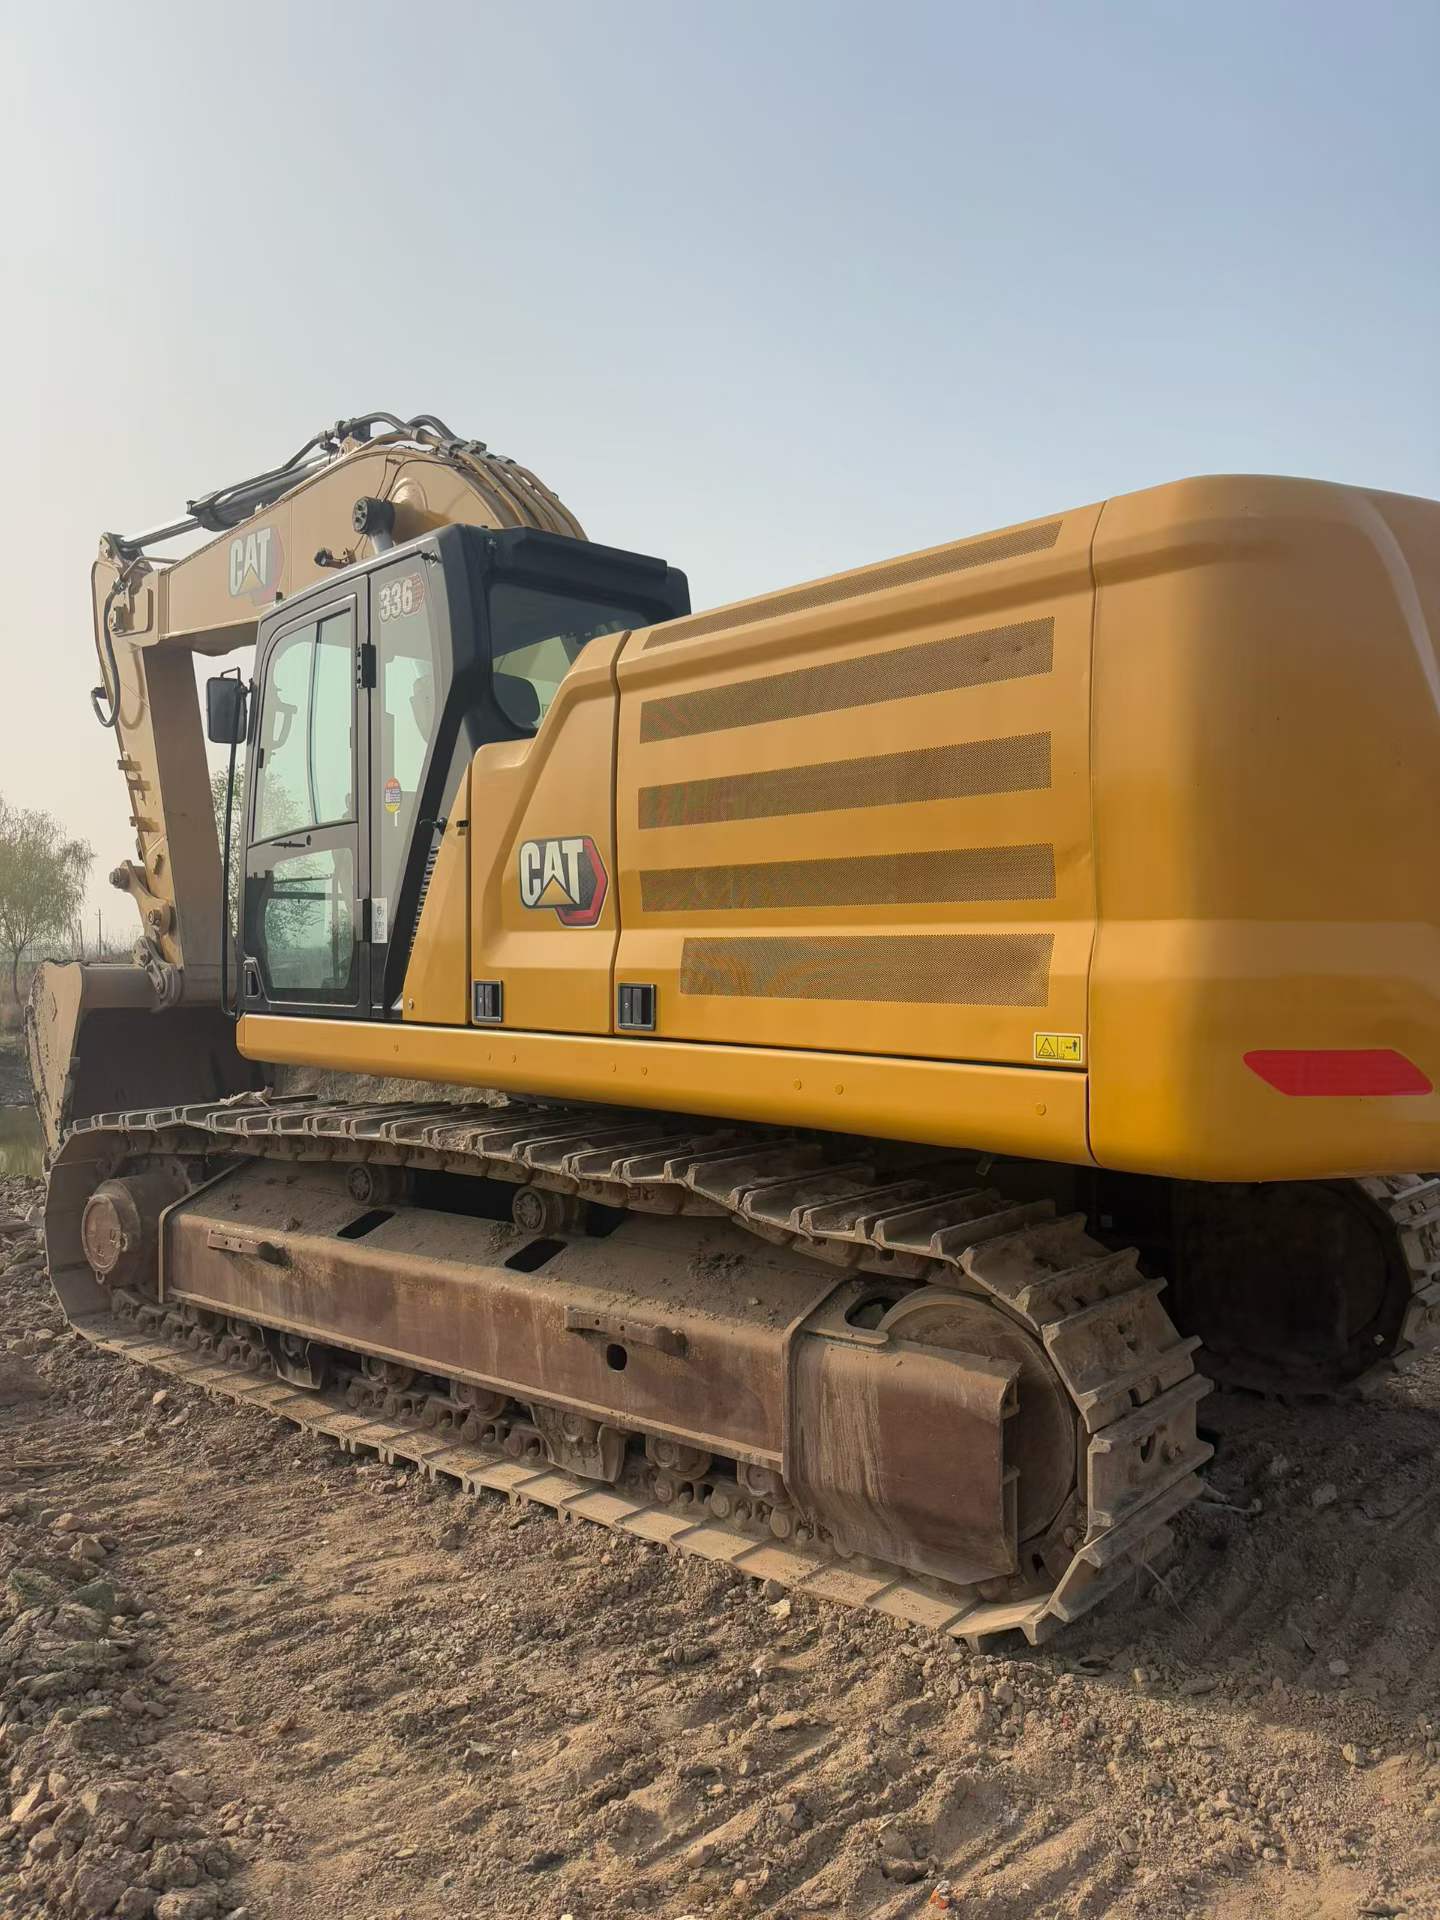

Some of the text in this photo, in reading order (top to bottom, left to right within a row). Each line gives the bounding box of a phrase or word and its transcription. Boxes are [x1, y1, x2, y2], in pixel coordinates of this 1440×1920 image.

[230, 528, 271, 596] CAT
[380, 579, 413, 621] 336
[520, 839, 584, 907] CAT
